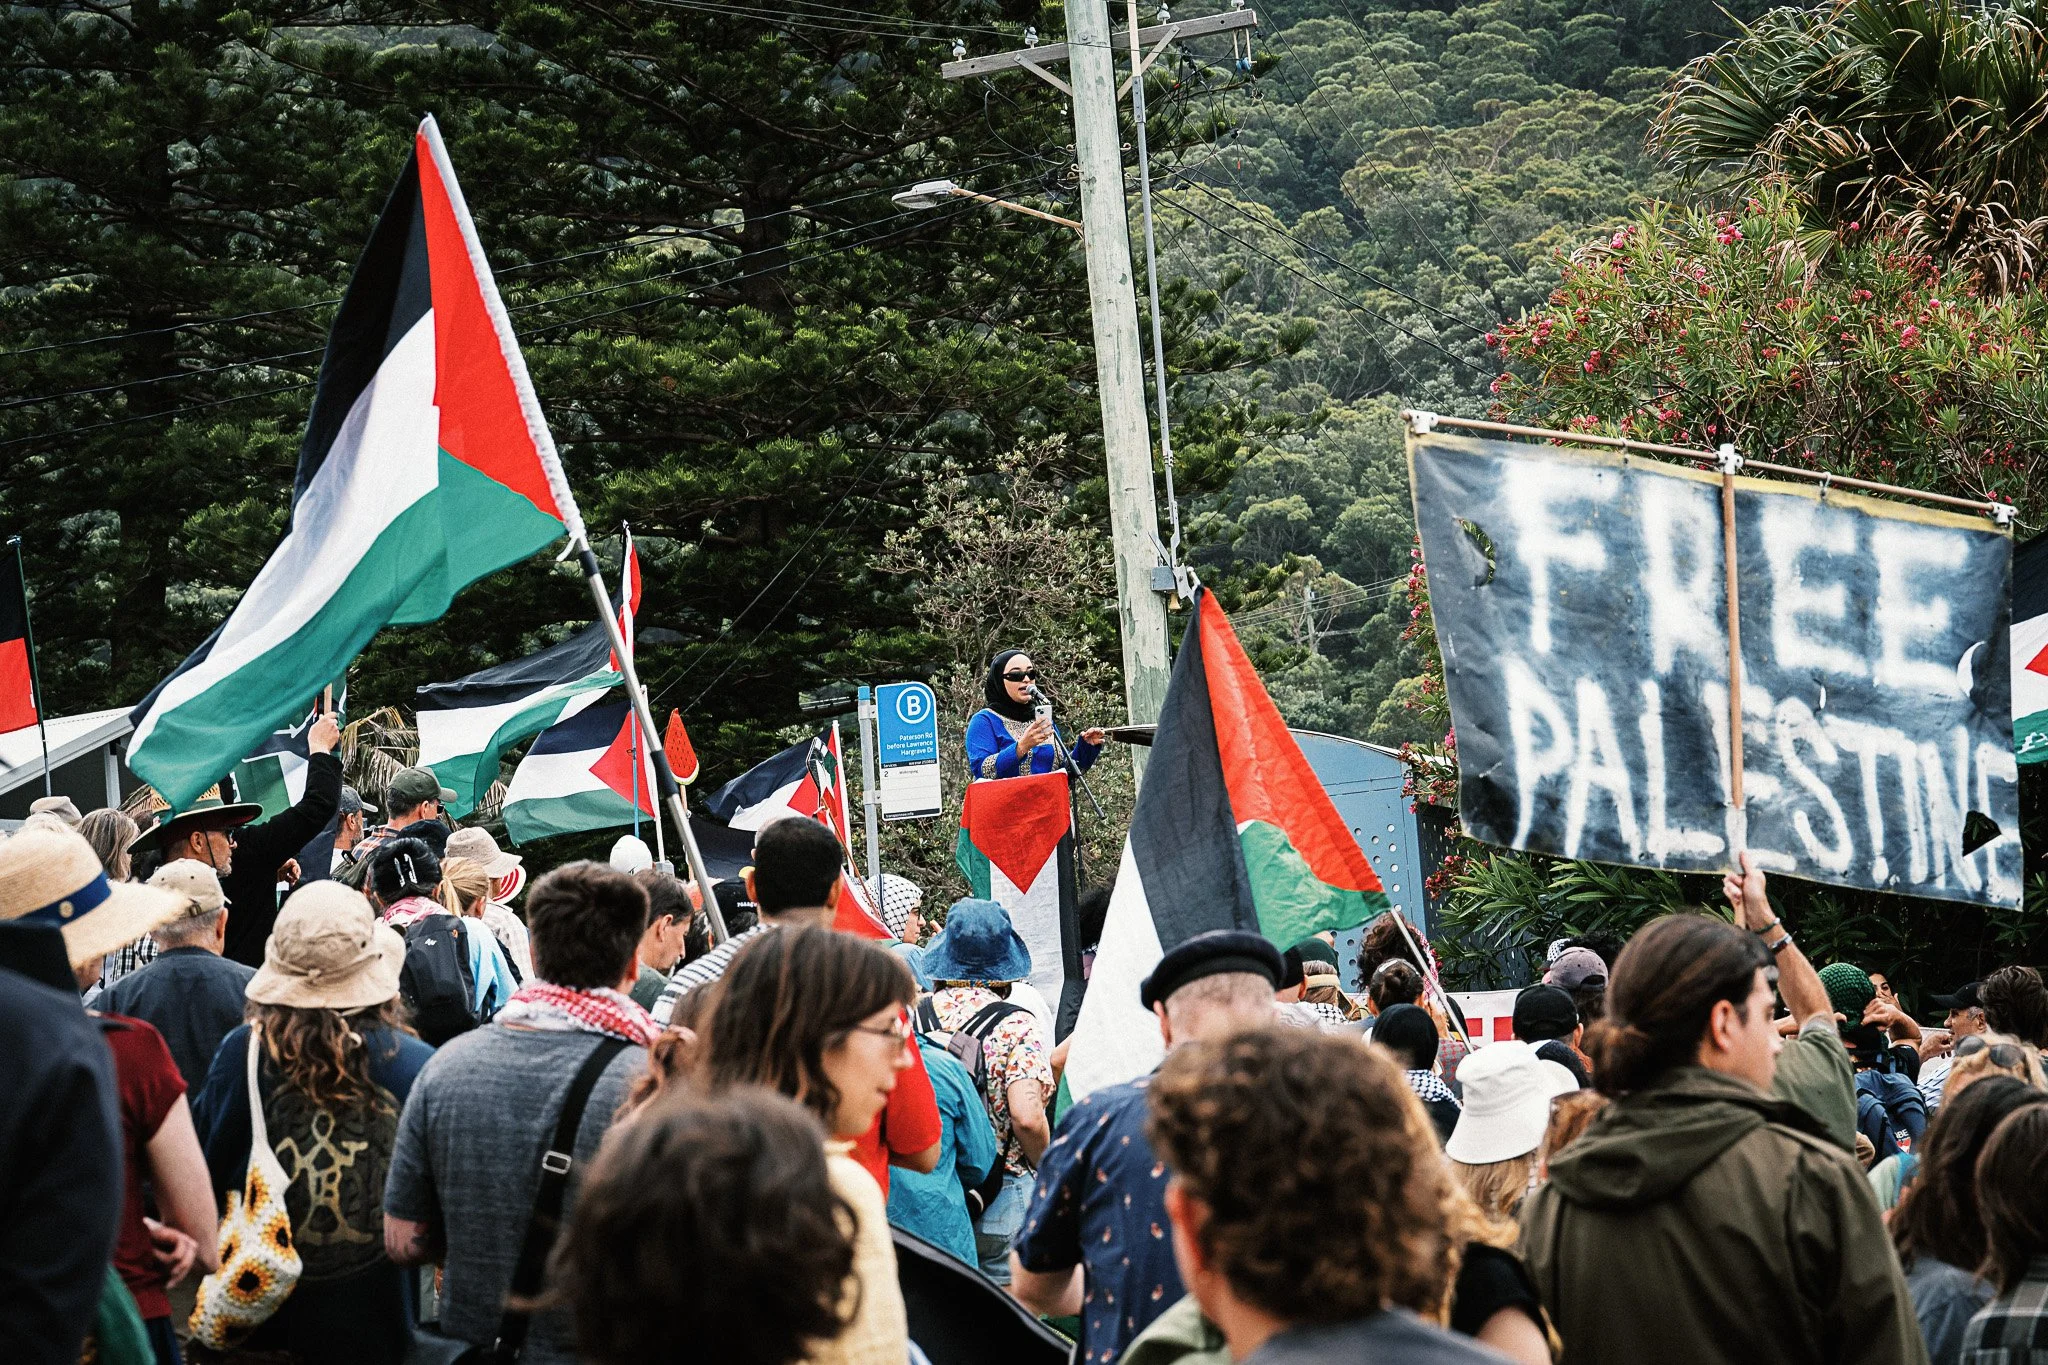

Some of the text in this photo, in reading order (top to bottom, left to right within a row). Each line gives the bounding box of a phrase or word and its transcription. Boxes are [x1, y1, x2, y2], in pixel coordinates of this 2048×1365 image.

[1501, 457, 1969, 697] FREE
[906, 695, 921, 716] B
[906, 740, 933, 748] Lawrence
[1501, 652, 2023, 905] PALESTINE
